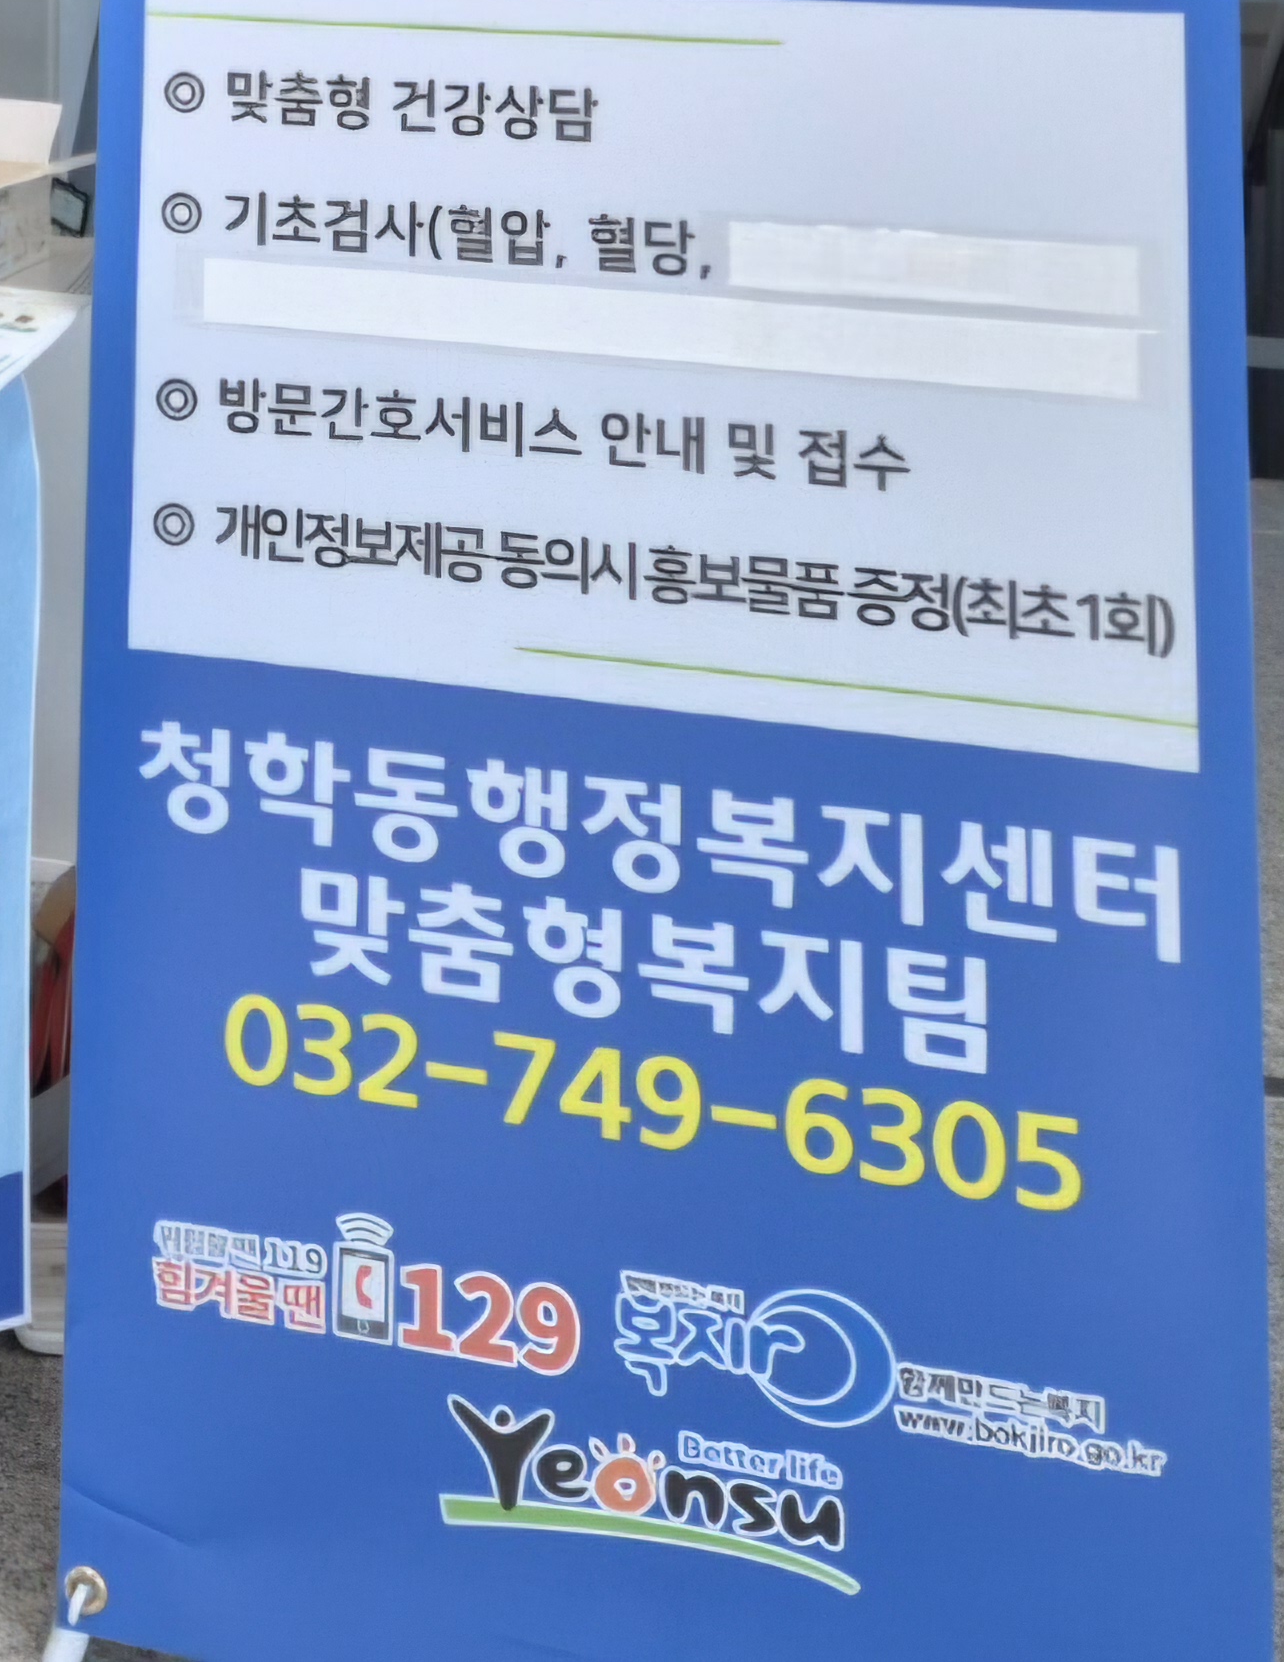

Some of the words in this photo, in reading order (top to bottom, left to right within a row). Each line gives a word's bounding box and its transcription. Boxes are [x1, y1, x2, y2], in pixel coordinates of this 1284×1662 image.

[224, 70, 372, 132] 맞춤형
[391, 78, 600, 144] 건강상담
[223, 190, 568, 270] 기초검사(혈압,
[588, 212, 713, 281] 혈당,
[217, 376, 582, 459] 방문간호서비스
[600, 409, 707, 474] 안내
[727, 420, 777, 480] 및
[797, 427, 913, 493] 접수
[215, 503, 492, 583] 개인정보제공
[499, 530, 638, 600] 동의시
[645, 543, 844, 619] 홍보물품
[139, 720, 1183, 965] 청학동행정복지센터
[298, 867, 992, 1076] 맞춤형복지팀
[223, 992, 1084, 1213] 032-749-6305
[264, 1238, 326, 1276] 119
[155, 1259, 275, 1323] 힘겨울
[283, 1283, 326, 1331] 땐
[399, 1264, 581, 1376] 129
[447, 1394, 846, 1552] Yeonsu
[679, 1431, 782, 1479] Better
[786, 1449, 843, 1490] life
